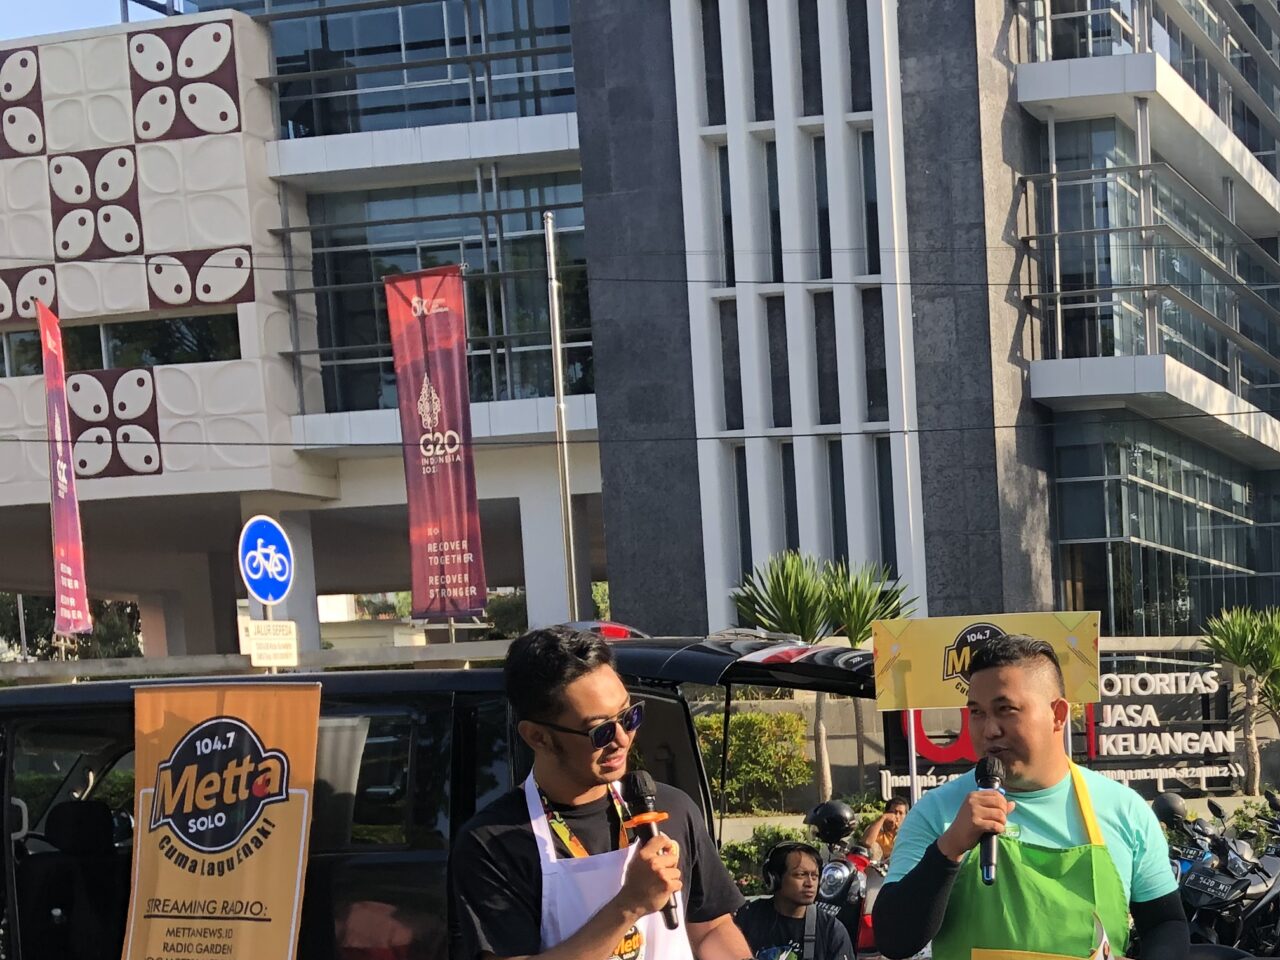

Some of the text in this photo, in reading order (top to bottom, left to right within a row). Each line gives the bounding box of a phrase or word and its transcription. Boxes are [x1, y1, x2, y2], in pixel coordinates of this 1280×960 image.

[419, 430, 461, 457] G20
[427, 540, 468, 553] RECOVER
[428, 553, 474, 566] TOGETHER
[428, 574, 469, 586] RECOVER
[429, 586, 477, 599] STRONGER
[967, 630, 990, 643] 104.7
[1100, 670, 1219, 697] OTORITAS
[1099, 703, 1160, 727] JASA
[195, 731, 236, 756] 104.7
[1099, 731, 1235, 756] KEUANGAN
[155, 754, 282, 821] Metta
[188, 812, 226, 833] SOLO
[158, 834, 199, 874] Cuma
[146, 898, 268, 916] STREAMING RADIO:
[165, 927, 233, 939] METTANEWS.ID
[162, 942, 233, 955] RADIO GARDEN
